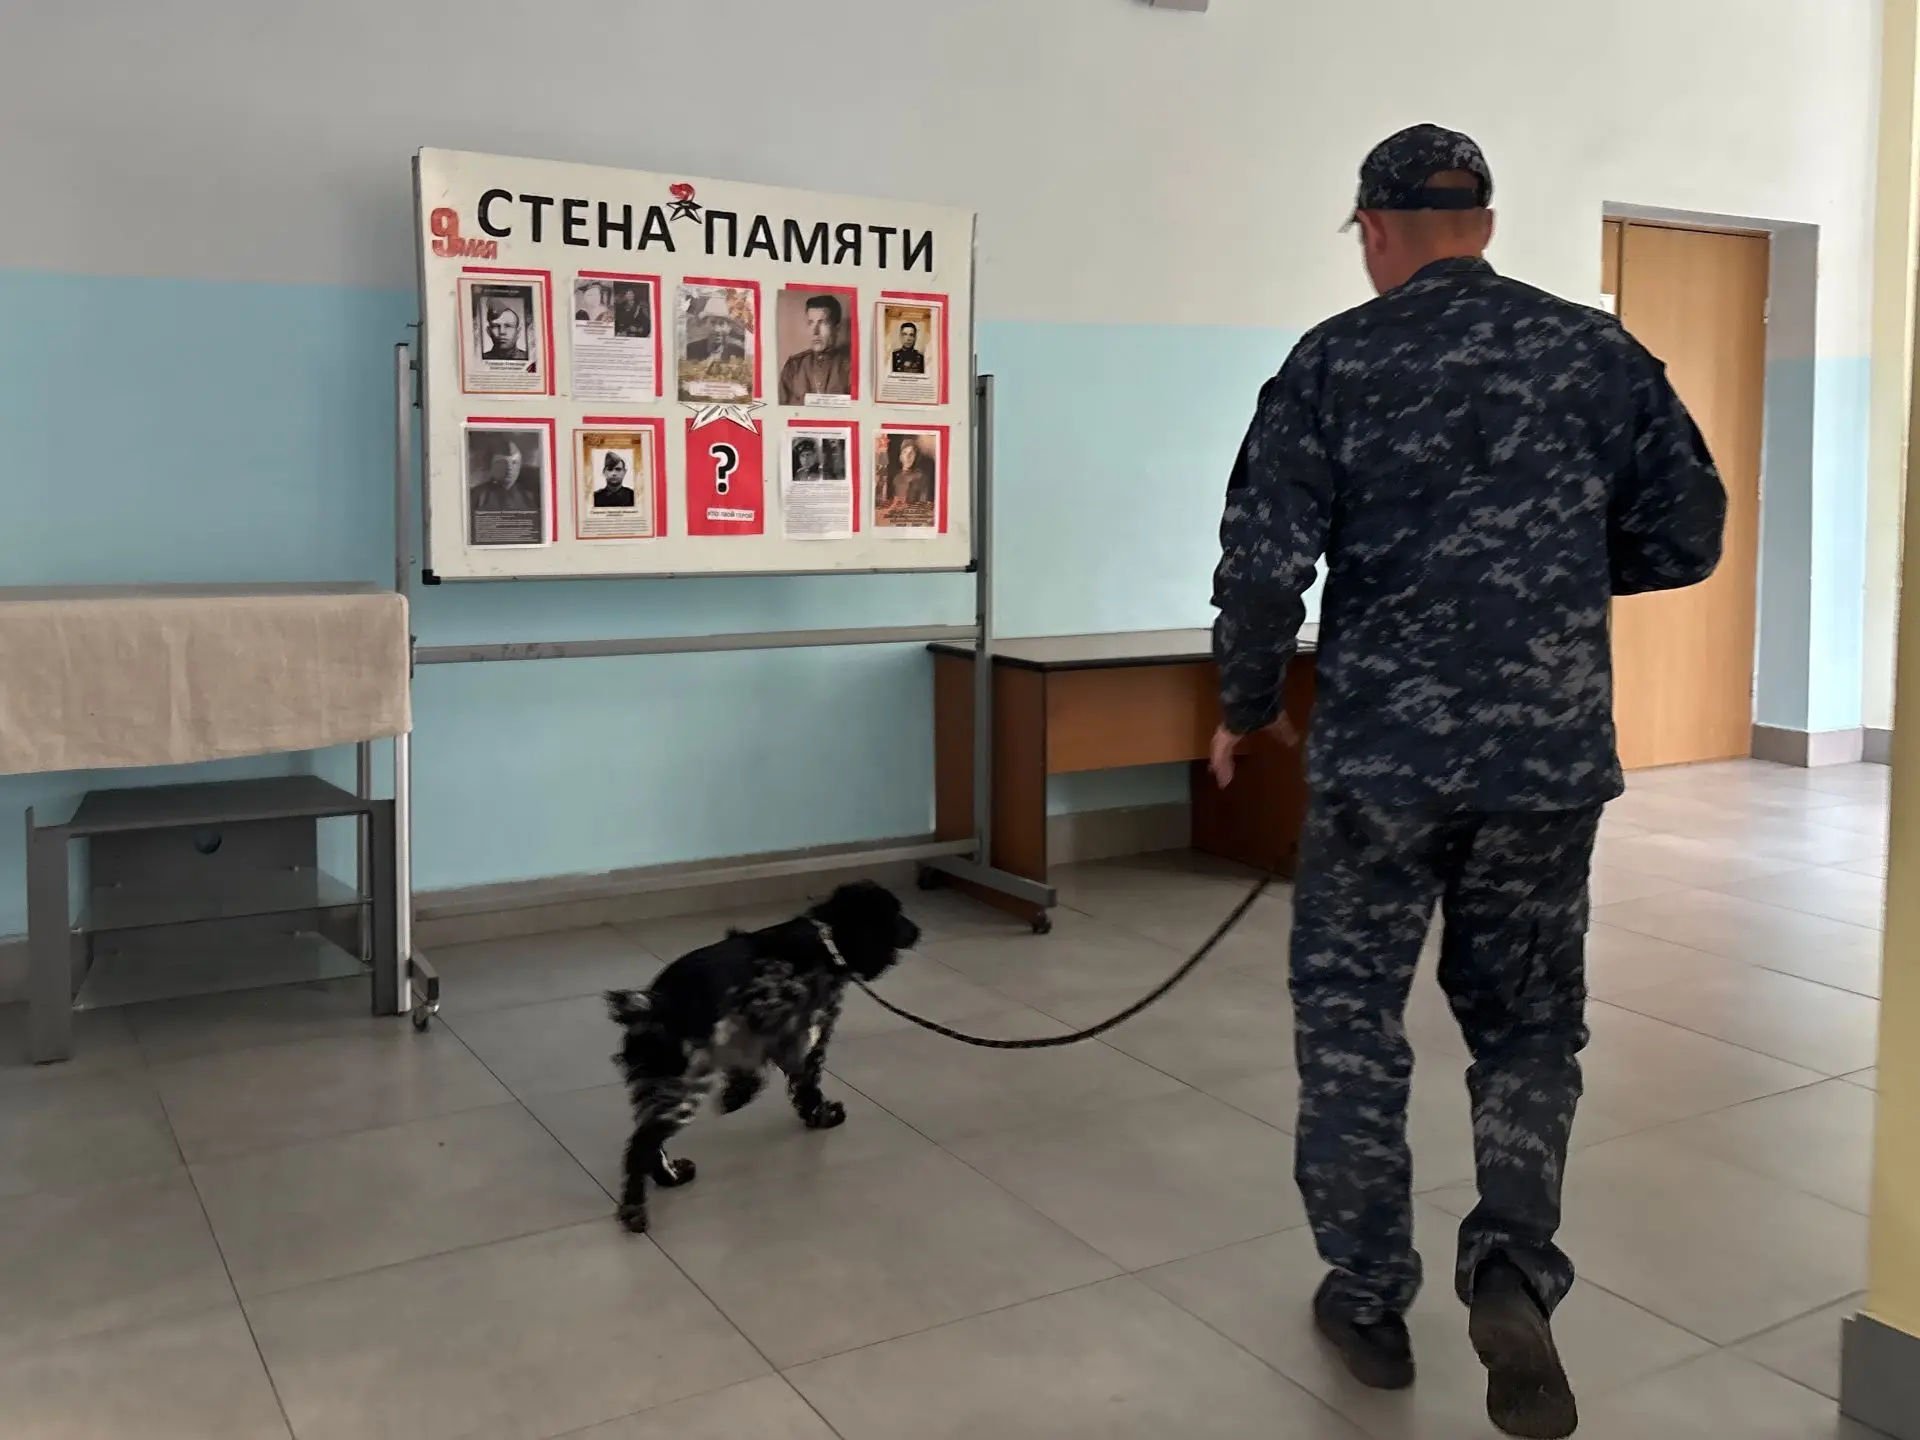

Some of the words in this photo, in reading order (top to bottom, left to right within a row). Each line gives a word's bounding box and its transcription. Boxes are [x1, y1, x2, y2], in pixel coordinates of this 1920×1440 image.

[430, 207, 459, 257] 9
[477, 188, 676, 252] СТЕНА
[705, 209, 933, 273] ПАМЯТИ
[709, 442, 739, 495] ?
